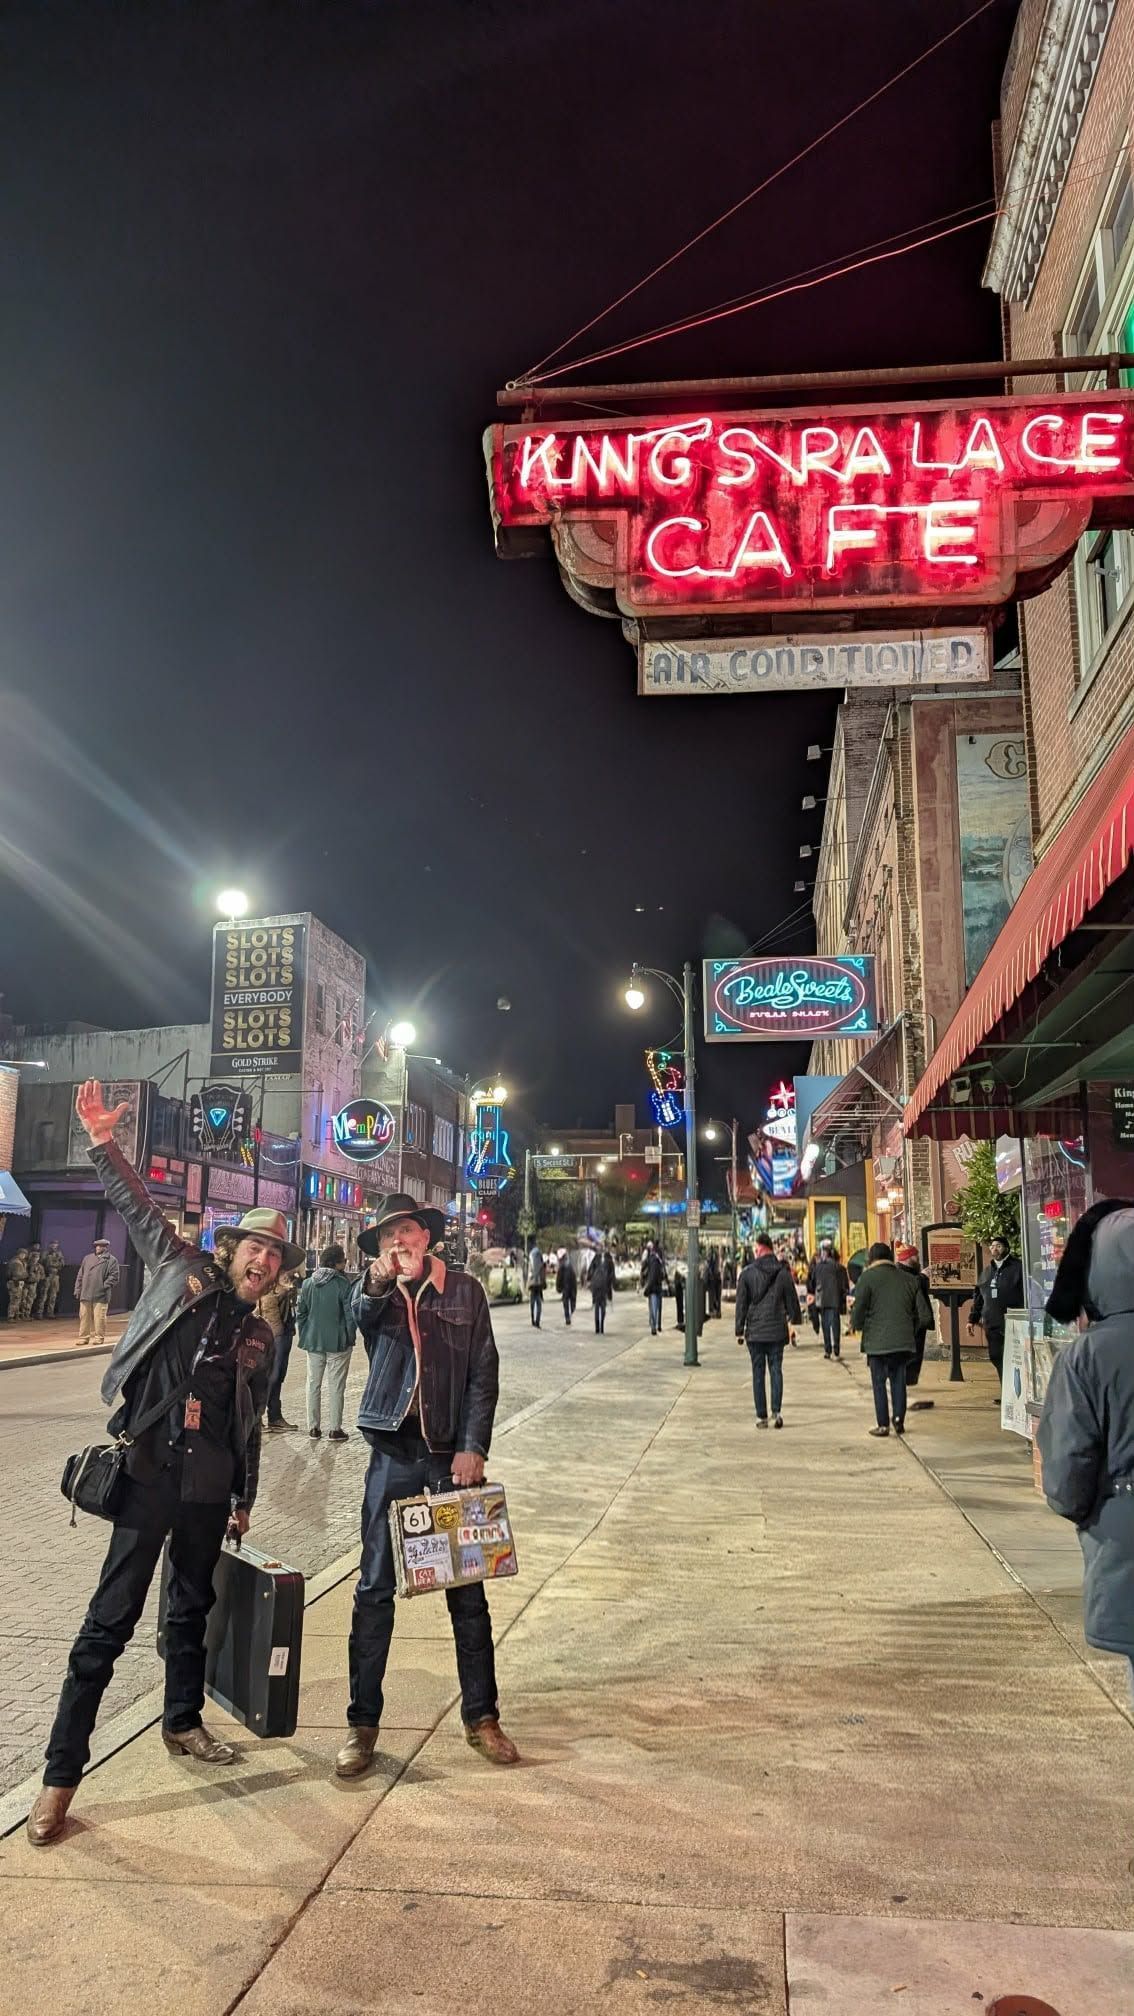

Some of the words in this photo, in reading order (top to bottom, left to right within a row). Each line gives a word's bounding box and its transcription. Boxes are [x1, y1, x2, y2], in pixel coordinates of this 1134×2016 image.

[520, 417, 756, 488] KING'S
[799, 413, 1124, 484] PALACE
[646, 500, 980, 577] CAFE
[653, 650, 711, 684] AIR
[729, 640, 973, 682] CONDITIONED
[226, 927, 295, 950] SLOTS
[225, 946, 294, 969] SLOTS
[224, 966, 293, 987] SLOTS
[224, 990, 293, 1005] EVERYBODY
[223, 1008, 292, 1030] SLOTS
[222, 1027, 291, 1049] SLOTS
[232, 1058, 252, 1068] GOLD
[253, 1056, 279, 1067] STRIKE
[479, 1179, 498, 1189] BLUES
[410, 1511, 425, 1527] 61
